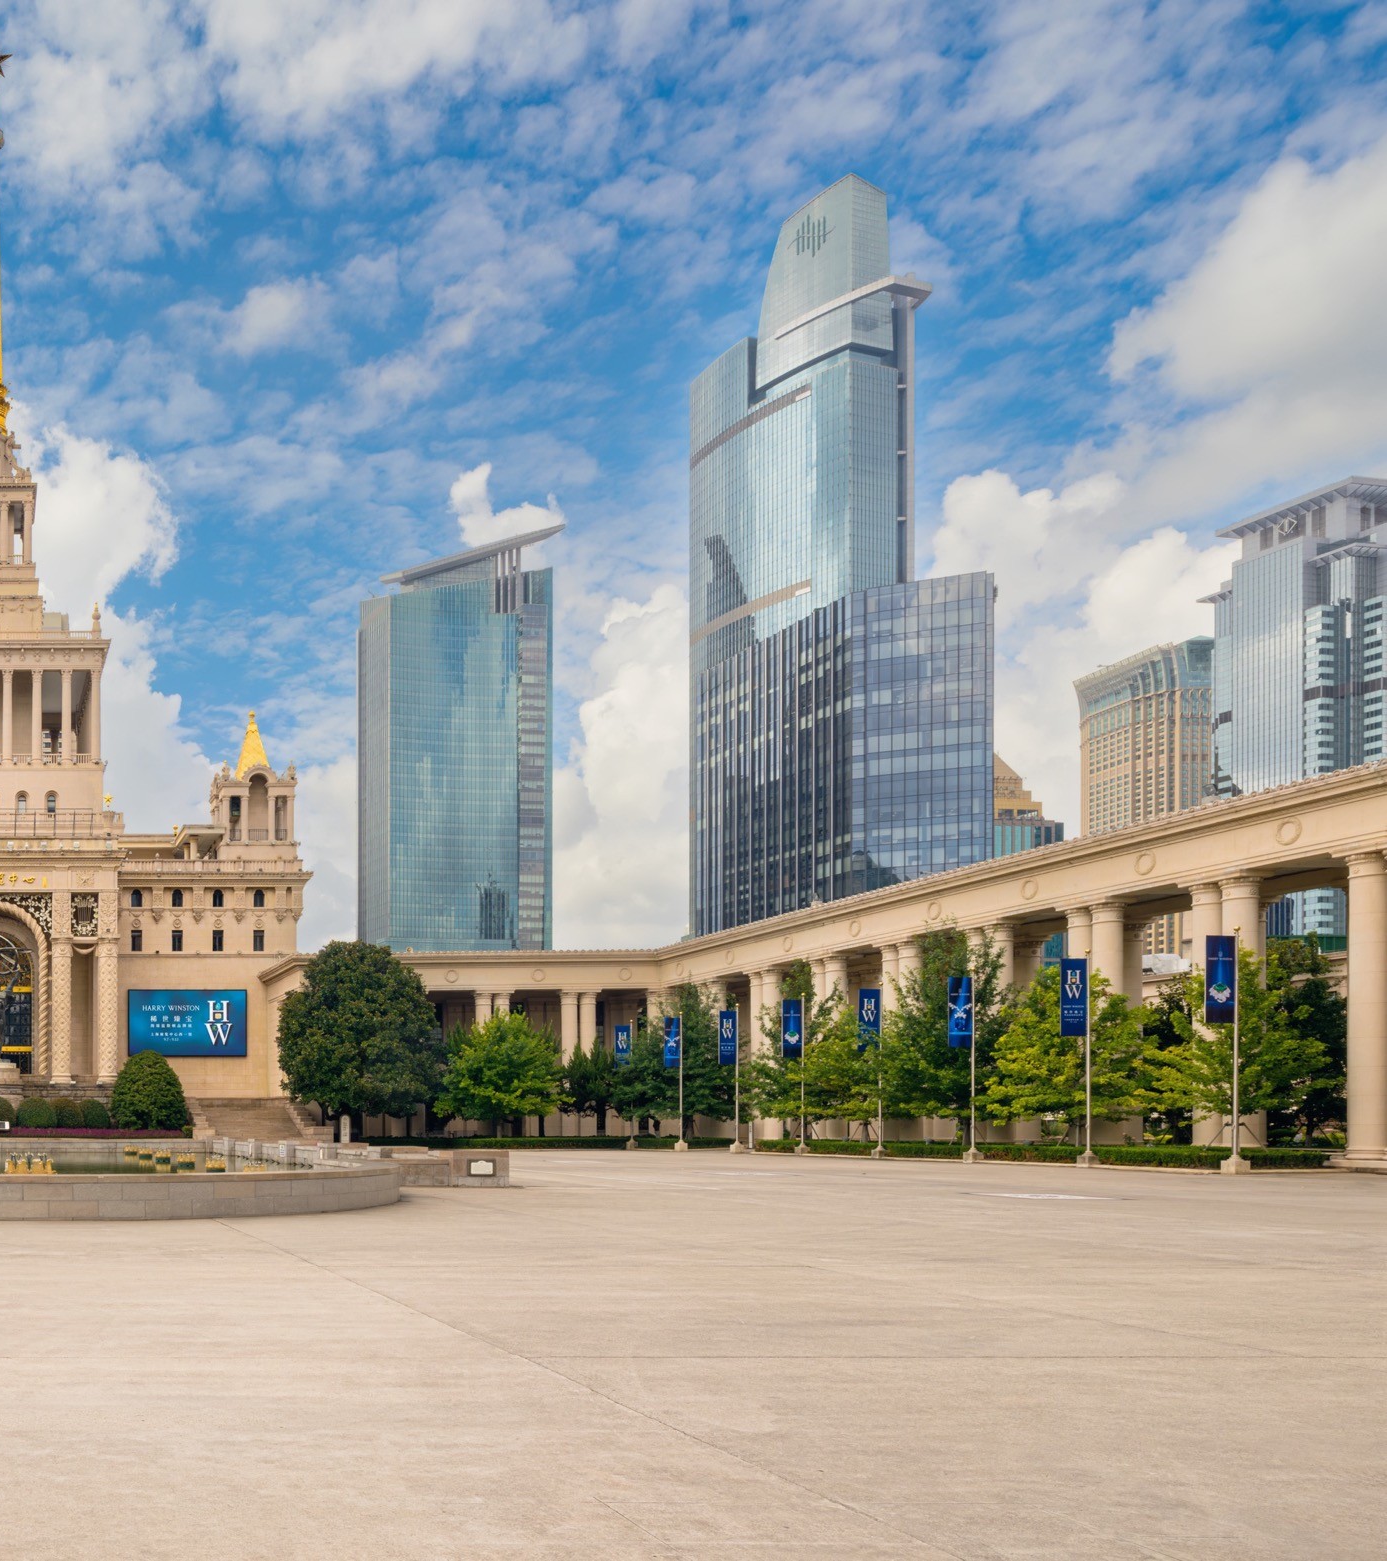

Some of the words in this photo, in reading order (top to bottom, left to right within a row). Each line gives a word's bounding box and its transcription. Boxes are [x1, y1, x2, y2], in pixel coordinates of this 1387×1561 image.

[1066, 970, 1081, 984] H
[1064, 984, 1083, 999] W
[207, 1000, 230, 1022] H
[863, 998, 875, 1010] H
[861, 1010, 877, 1023] W
[204, 1022, 233, 1046] W
